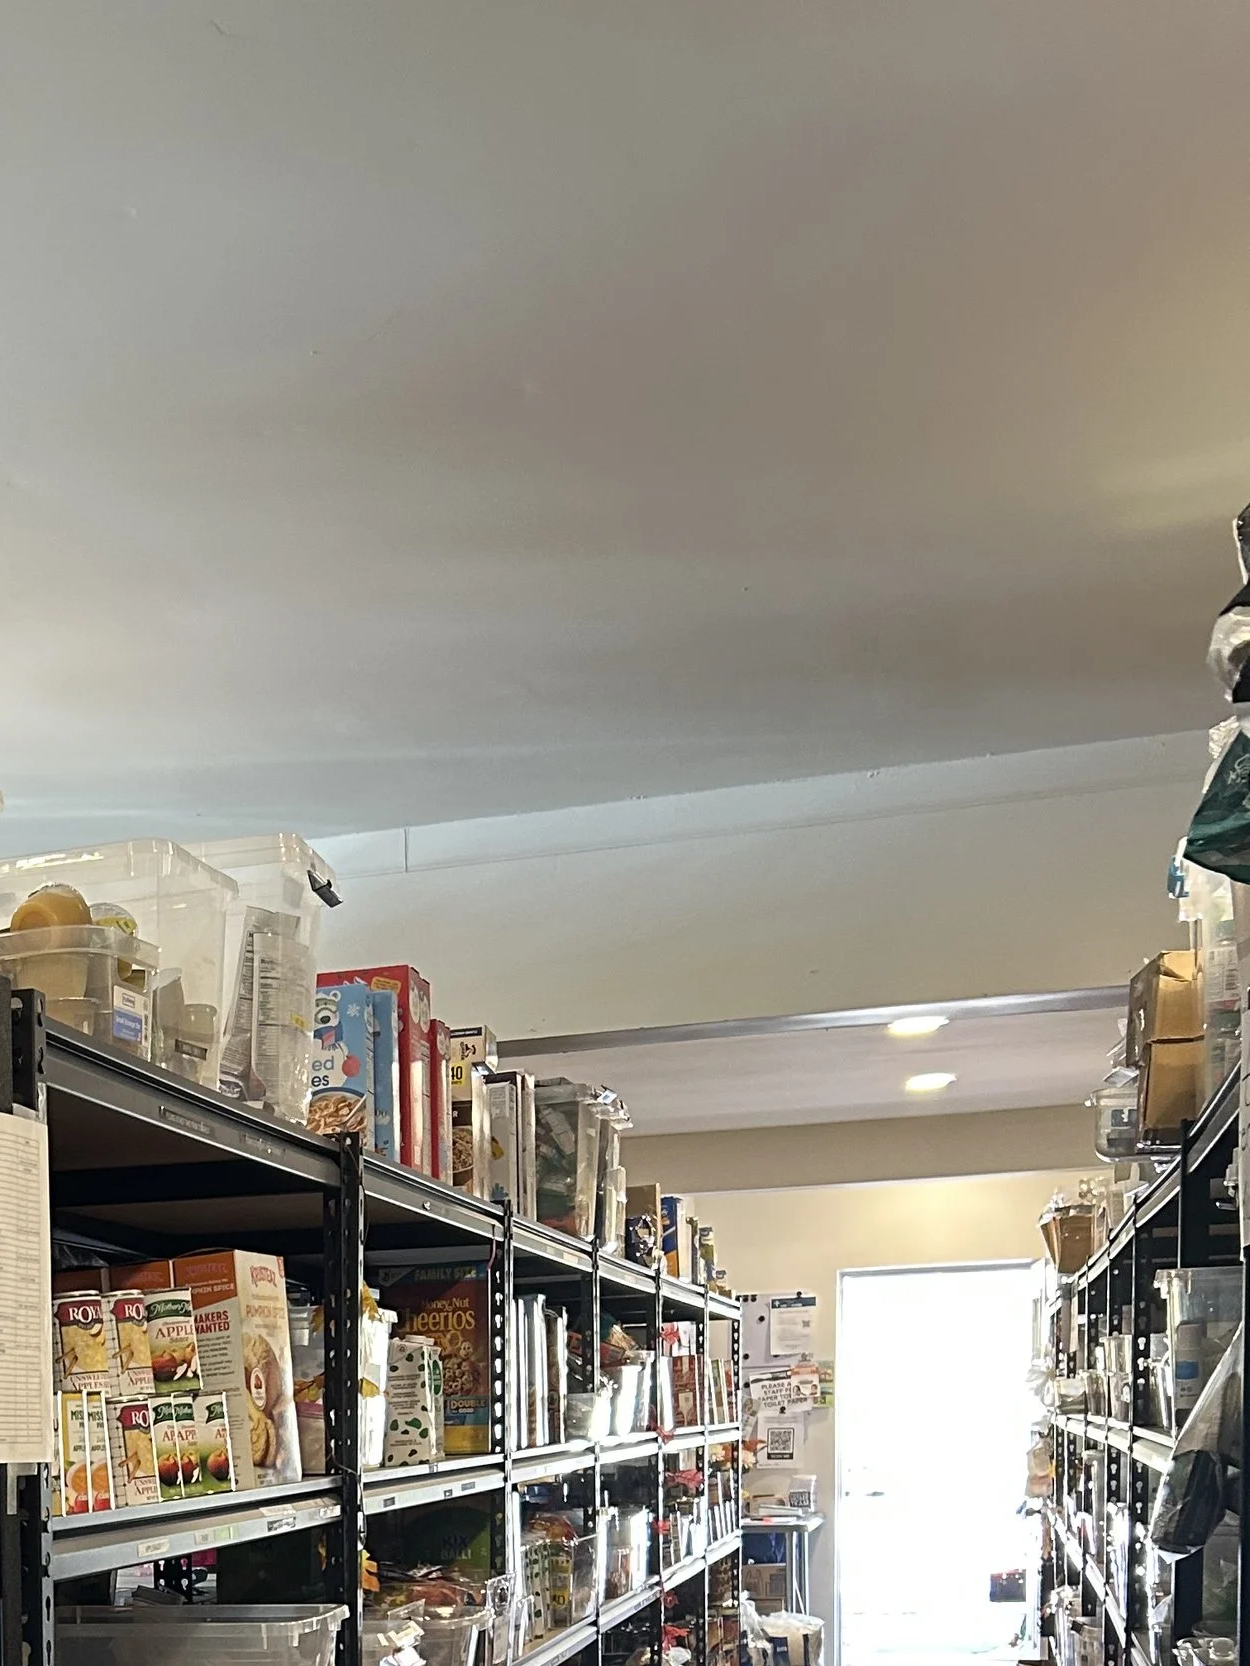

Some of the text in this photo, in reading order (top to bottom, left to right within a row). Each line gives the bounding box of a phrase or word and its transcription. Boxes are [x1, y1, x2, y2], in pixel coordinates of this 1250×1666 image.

[312, 1056, 334, 1072] ed
[311, 1075, 330, 1088] es
[452, 1297, 470, 1308] Nut
[763, 1400, 785, 1408] TOILET
